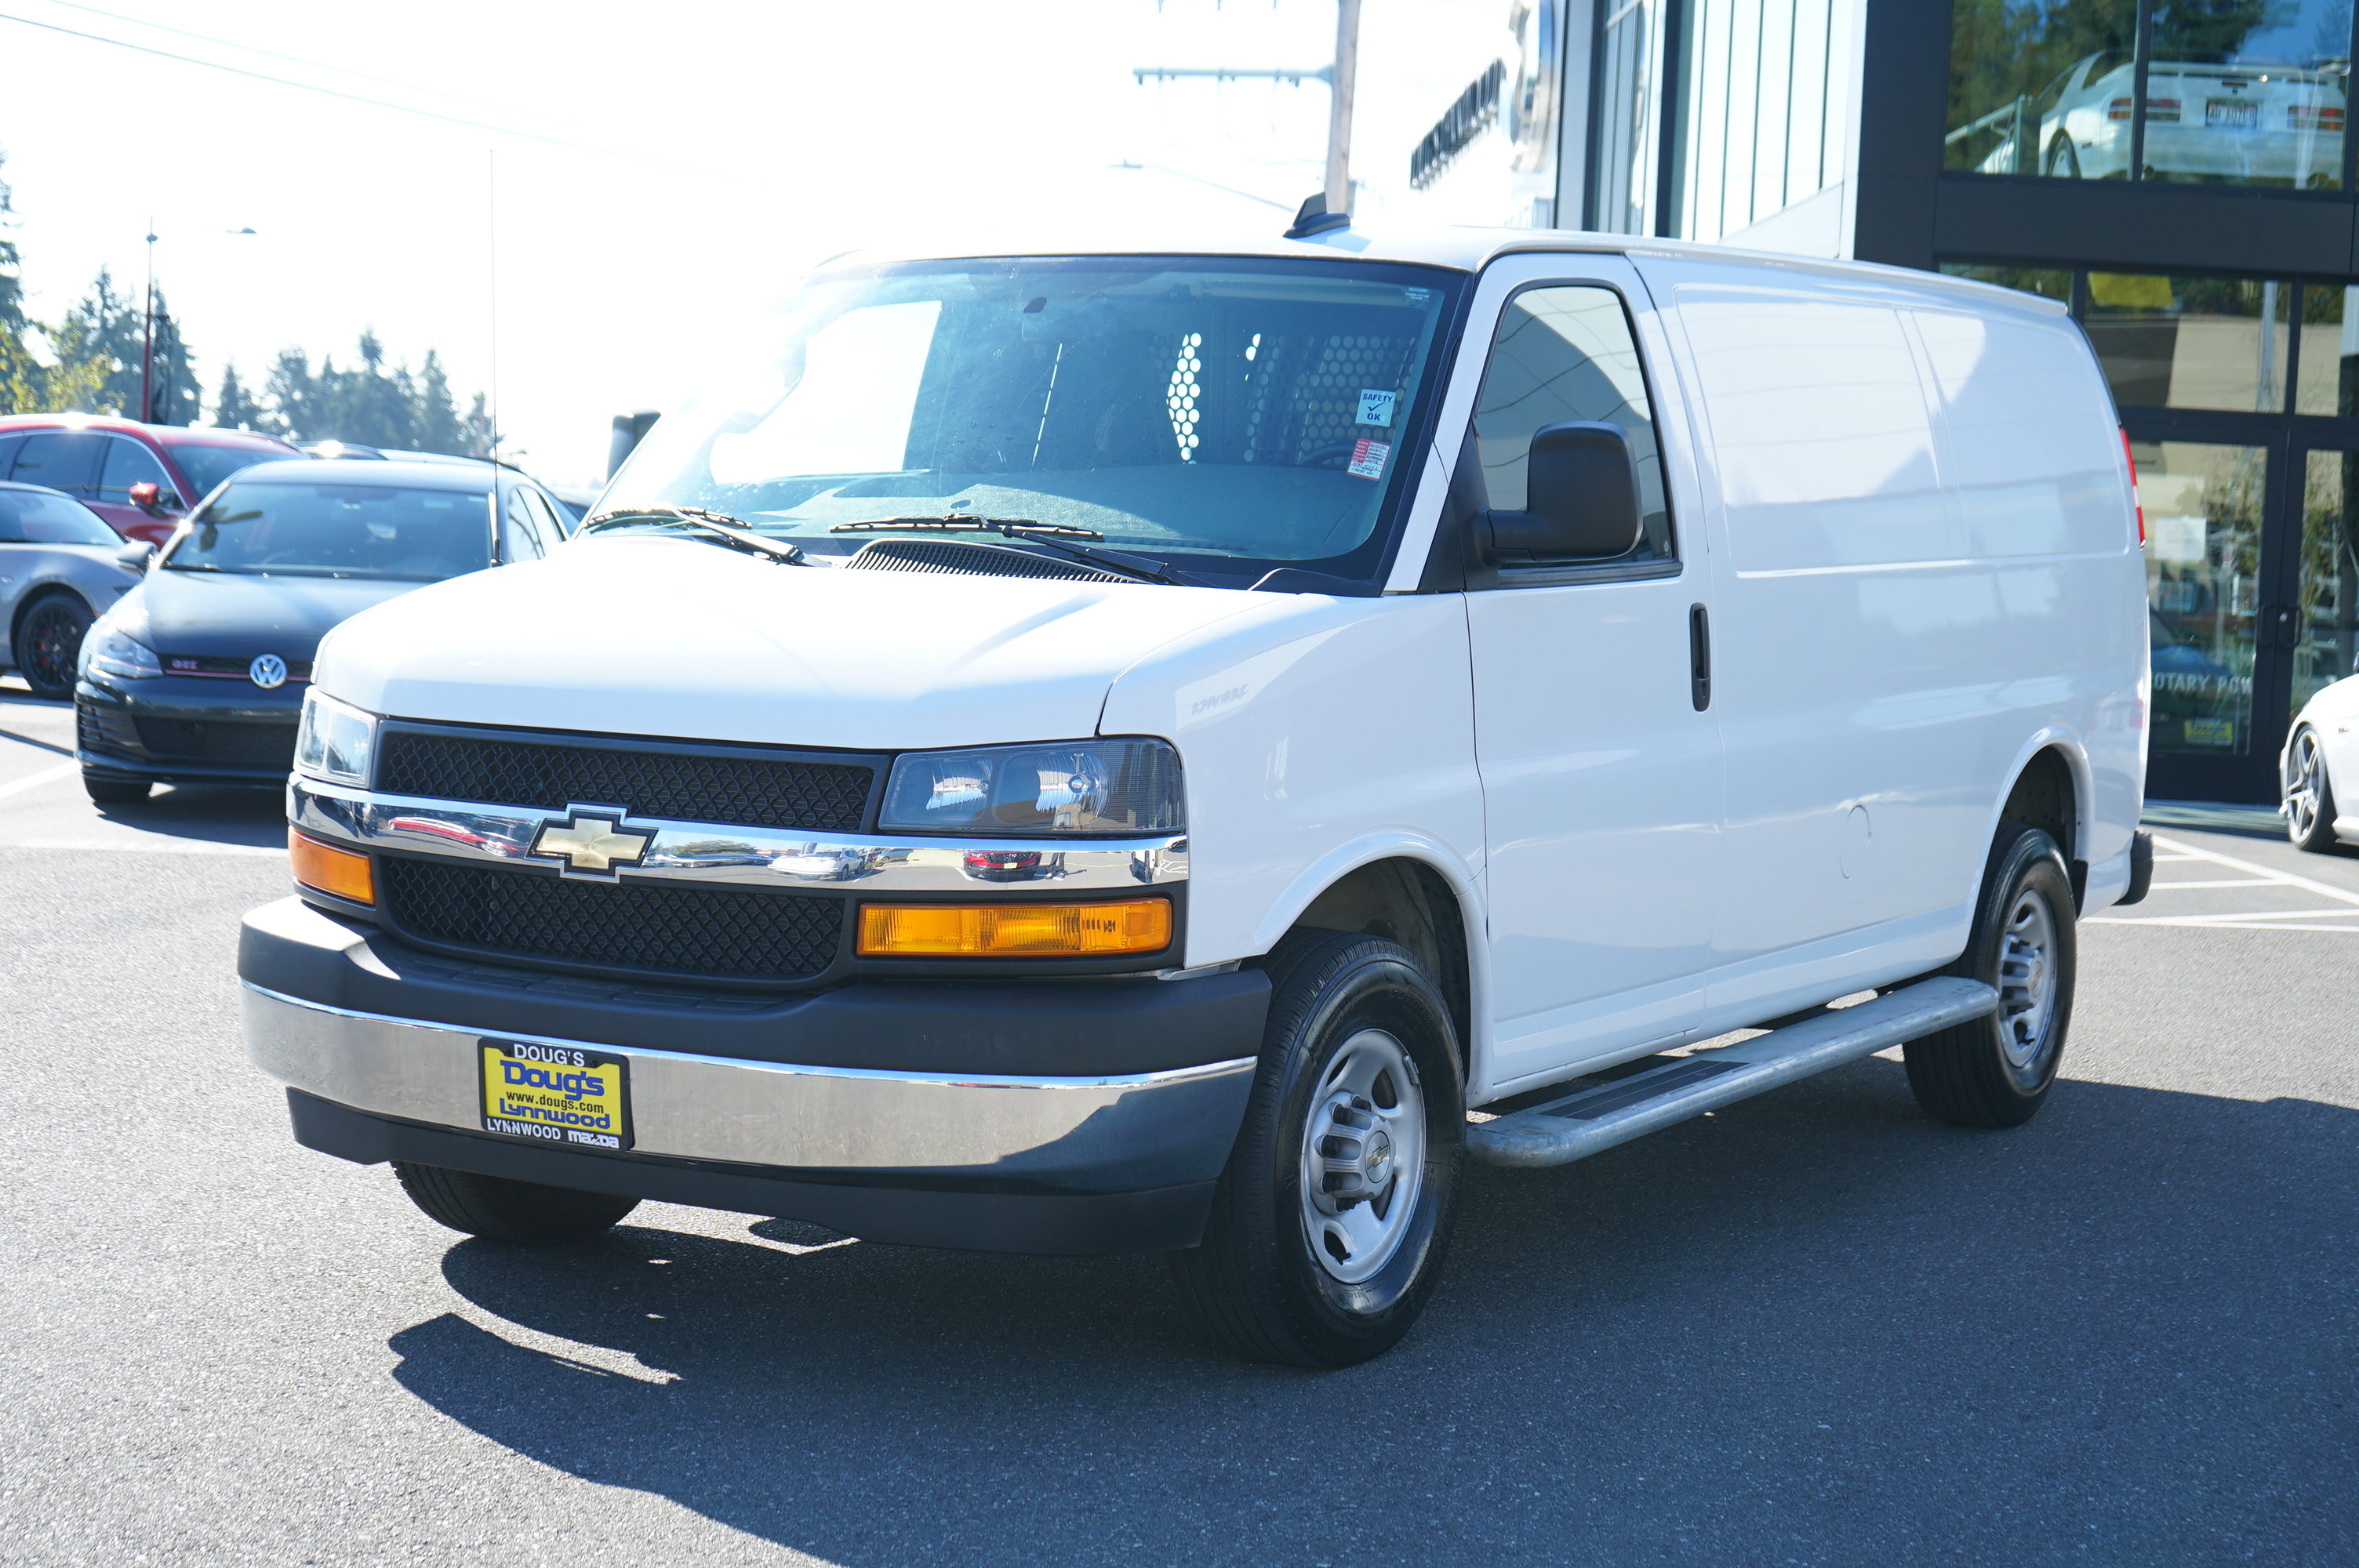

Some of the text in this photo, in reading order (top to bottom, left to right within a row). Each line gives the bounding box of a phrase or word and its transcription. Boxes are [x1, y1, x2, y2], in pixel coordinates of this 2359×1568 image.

[1363, 393, 1393, 402] SAFETY
[1367, 412, 1381, 421] OK
[2153, 672, 2210, 692] OTARY
[514, 1044, 585, 1067] DOUG'S
[500, 1060, 605, 1102] Doug's
[500, 1098, 610, 1130] Lynnwood
[506, 1091, 605, 1114] www.dougs.com
[486, 1118, 562, 1141] LYNNWOOD
